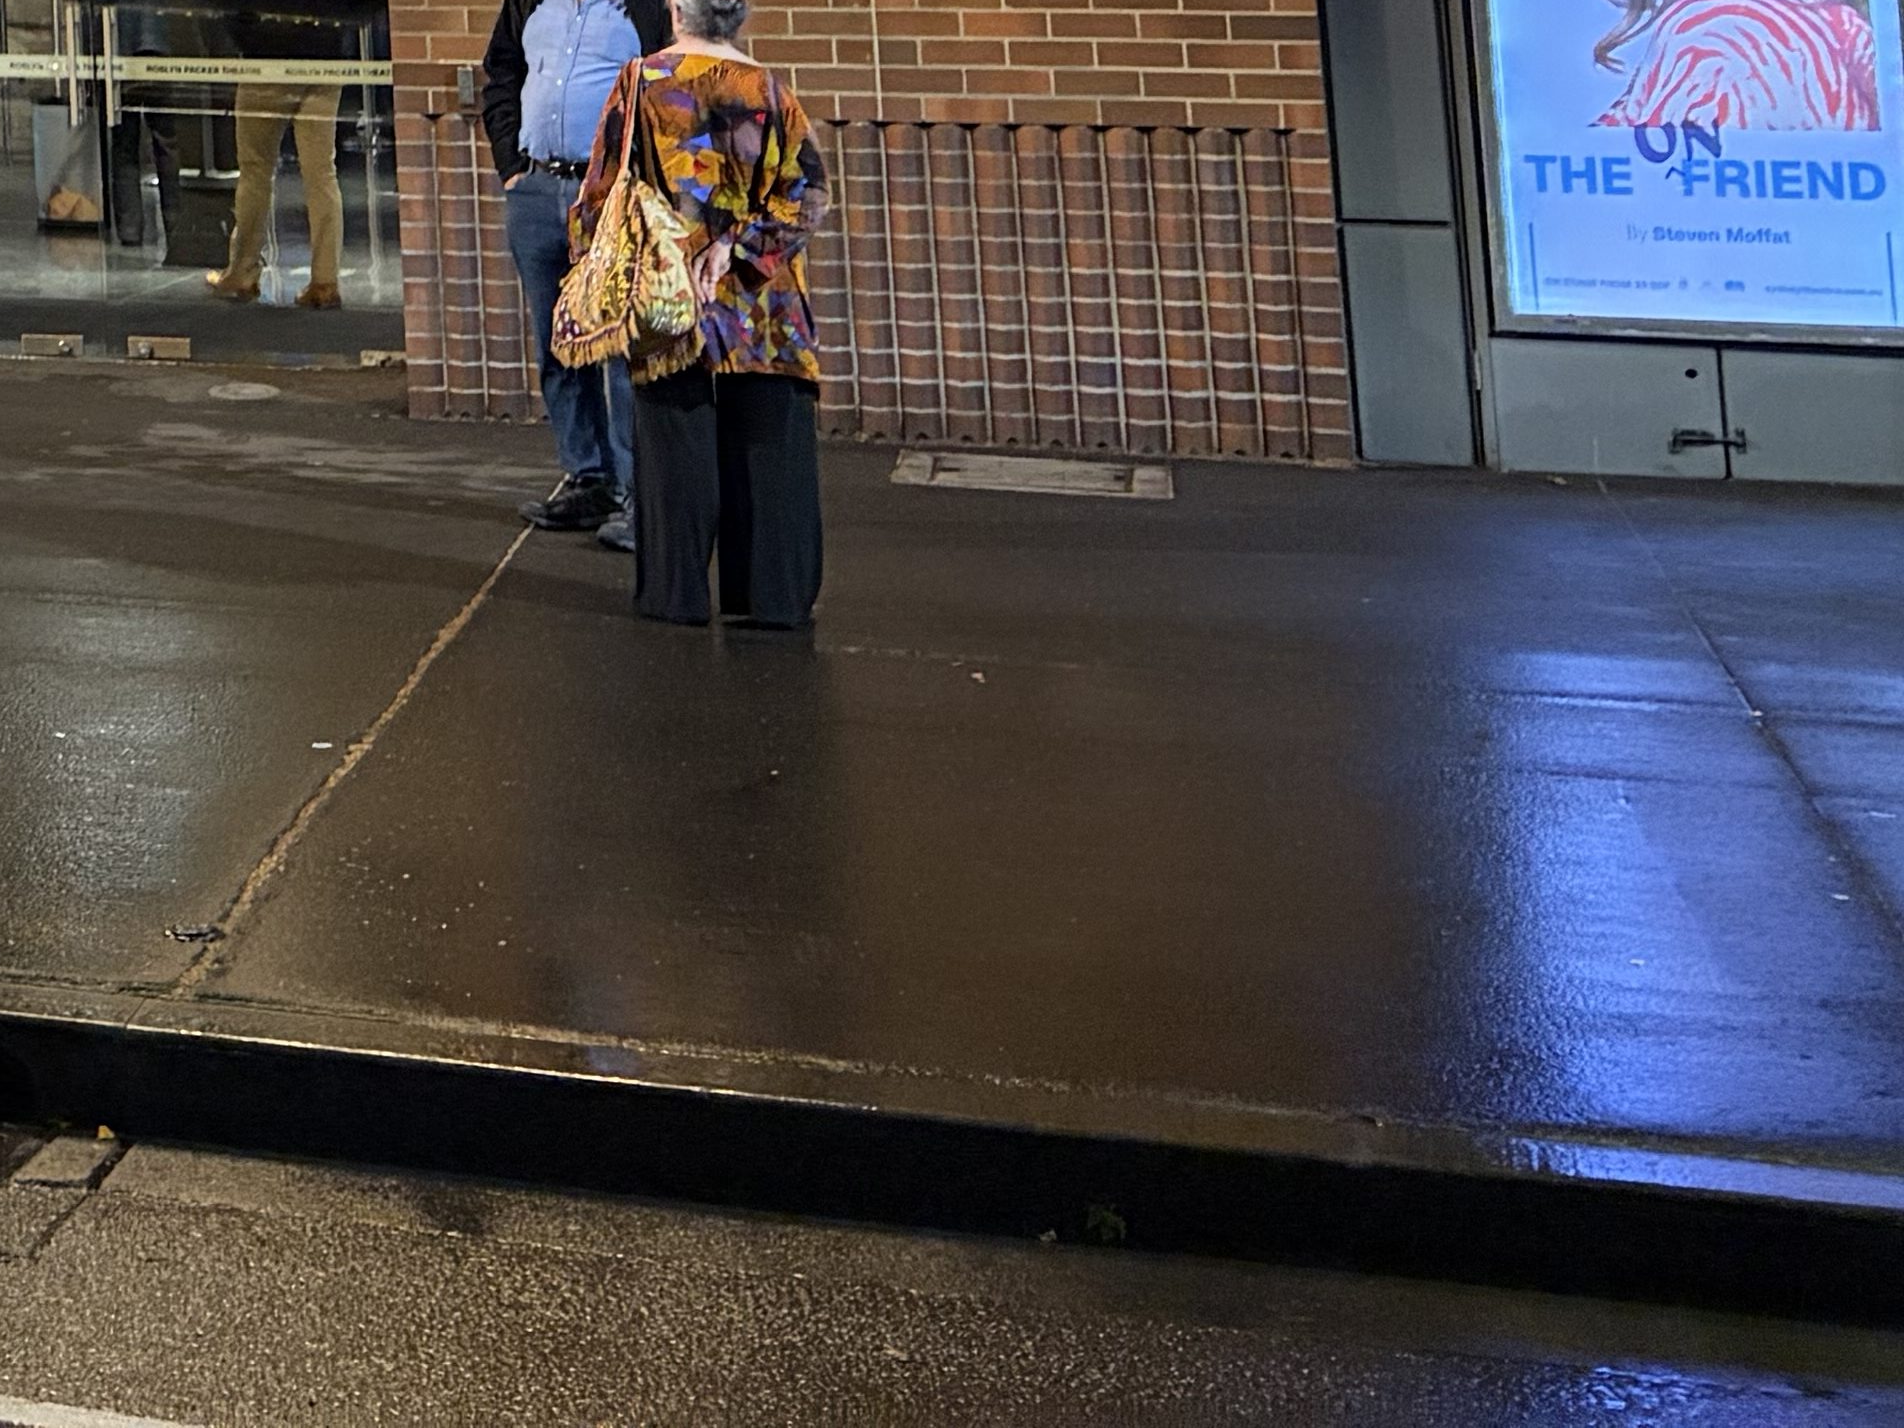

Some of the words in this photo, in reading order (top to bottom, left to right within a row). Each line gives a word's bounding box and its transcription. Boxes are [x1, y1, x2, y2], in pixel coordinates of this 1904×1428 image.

[1633, 120, 1722, 164] UN
[1523, 153, 1634, 196] THE
[1682, 159, 1887, 202] FRIEND
[1626, 224, 1647, 244] By
[1652, 226, 1720, 243] Steven
[1726, 227, 1791, 245] Moffat
